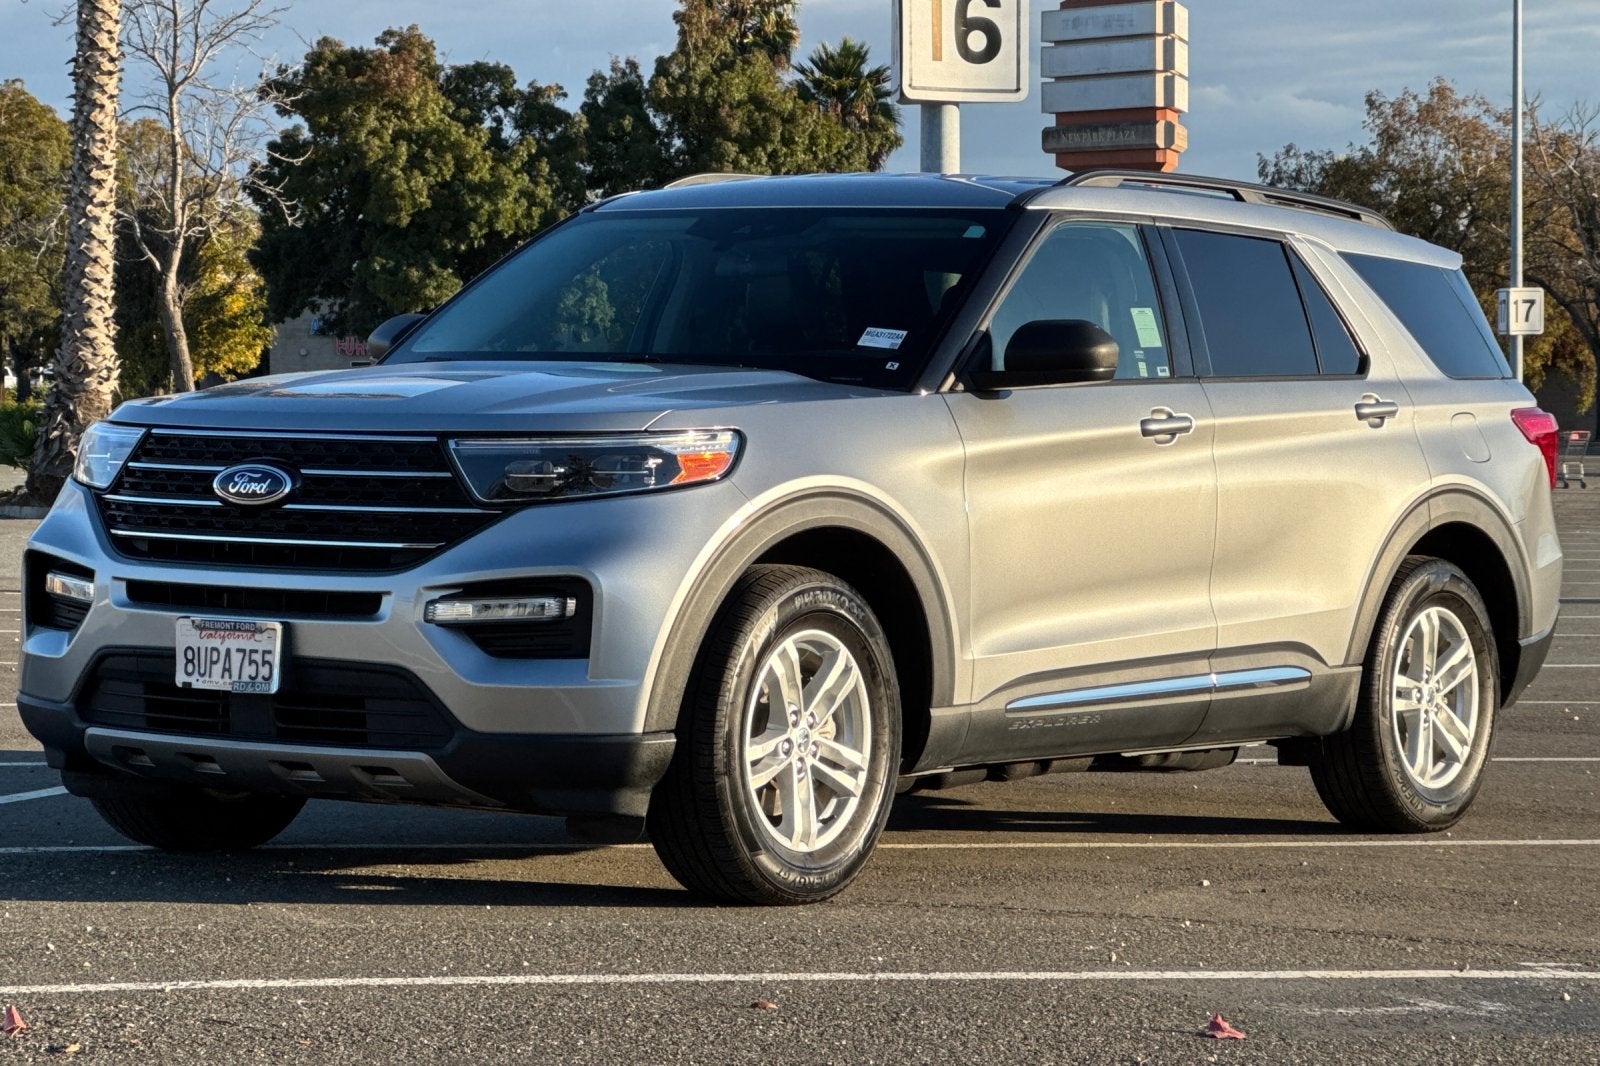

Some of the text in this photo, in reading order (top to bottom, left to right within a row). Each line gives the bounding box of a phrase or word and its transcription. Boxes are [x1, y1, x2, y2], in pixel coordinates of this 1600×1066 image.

[931, 0, 1002, 64] 16
[1513, 299, 1537, 323] 17
[336, 336, 369, 356] FUR
[228, 471, 272, 494] Ford
[199, 629, 262, 645] California
[201, 621, 256, 631] FREMONT FORD
[183, 645, 273, 682] 8UPA755
